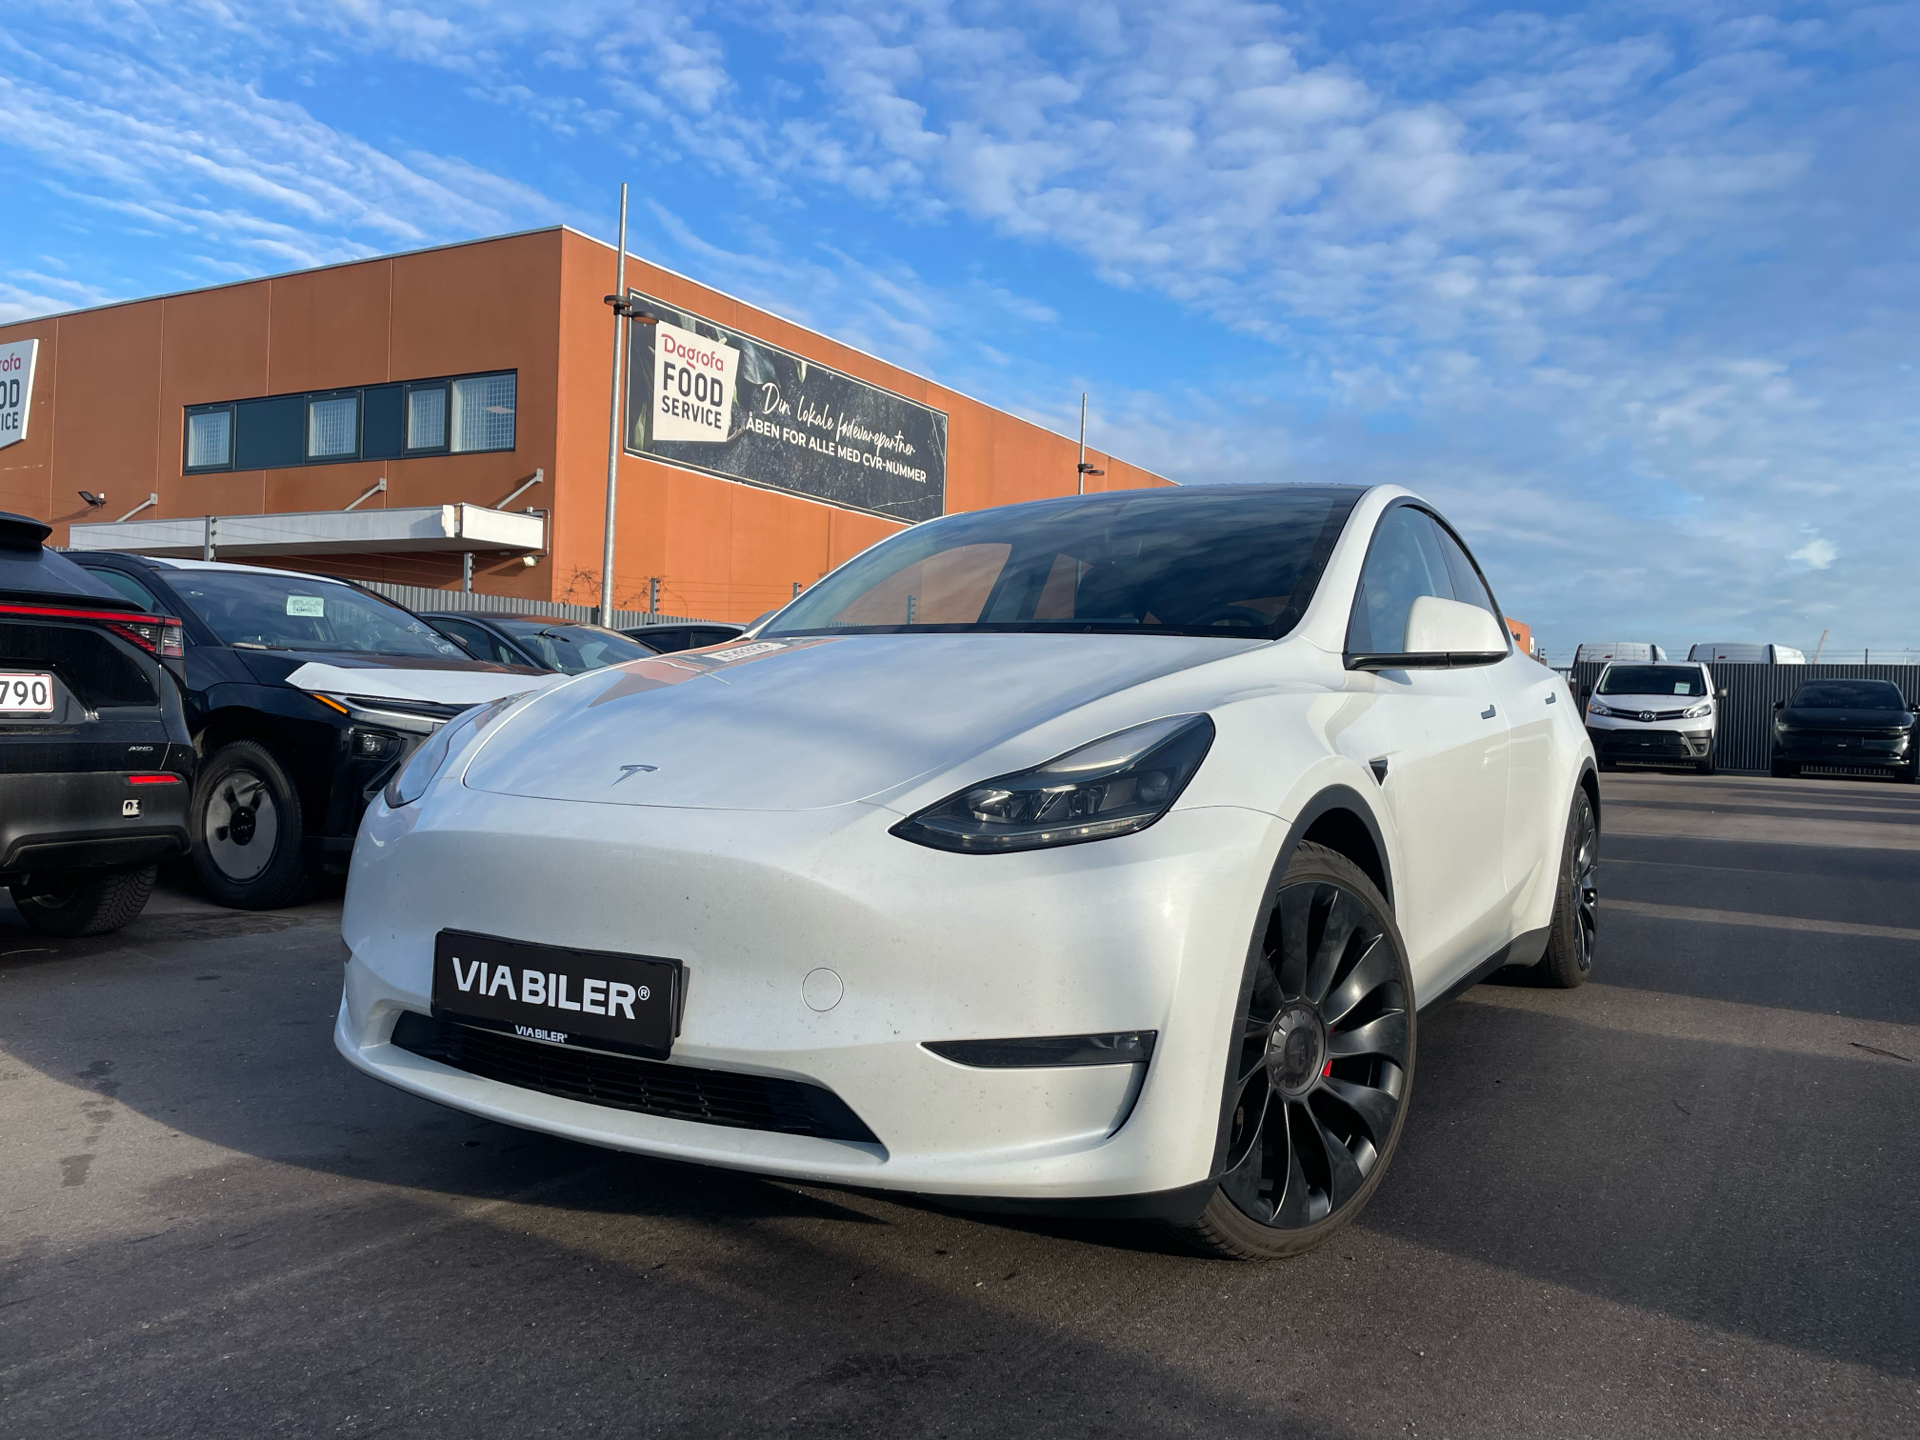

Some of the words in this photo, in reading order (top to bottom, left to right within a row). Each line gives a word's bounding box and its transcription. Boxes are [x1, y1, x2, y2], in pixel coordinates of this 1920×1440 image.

[661, 333, 724, 371] Dagrofa
[663, 361, 724, 407] FOOD
[661, 395, 722, 430] SERVICE
[762, 382, 791, 415] Din
[797, 395, 834, 430] lokale
[746, 411, 780, 439] ÅBEN
[783, 427, 806, 447] FOR
[808, 436, 835, 456] ALLE
[837, 444, 860, 463] MED
[862, 453, 927, 484] CVR-NUMMER
[0, 681, 47, 706] 790
